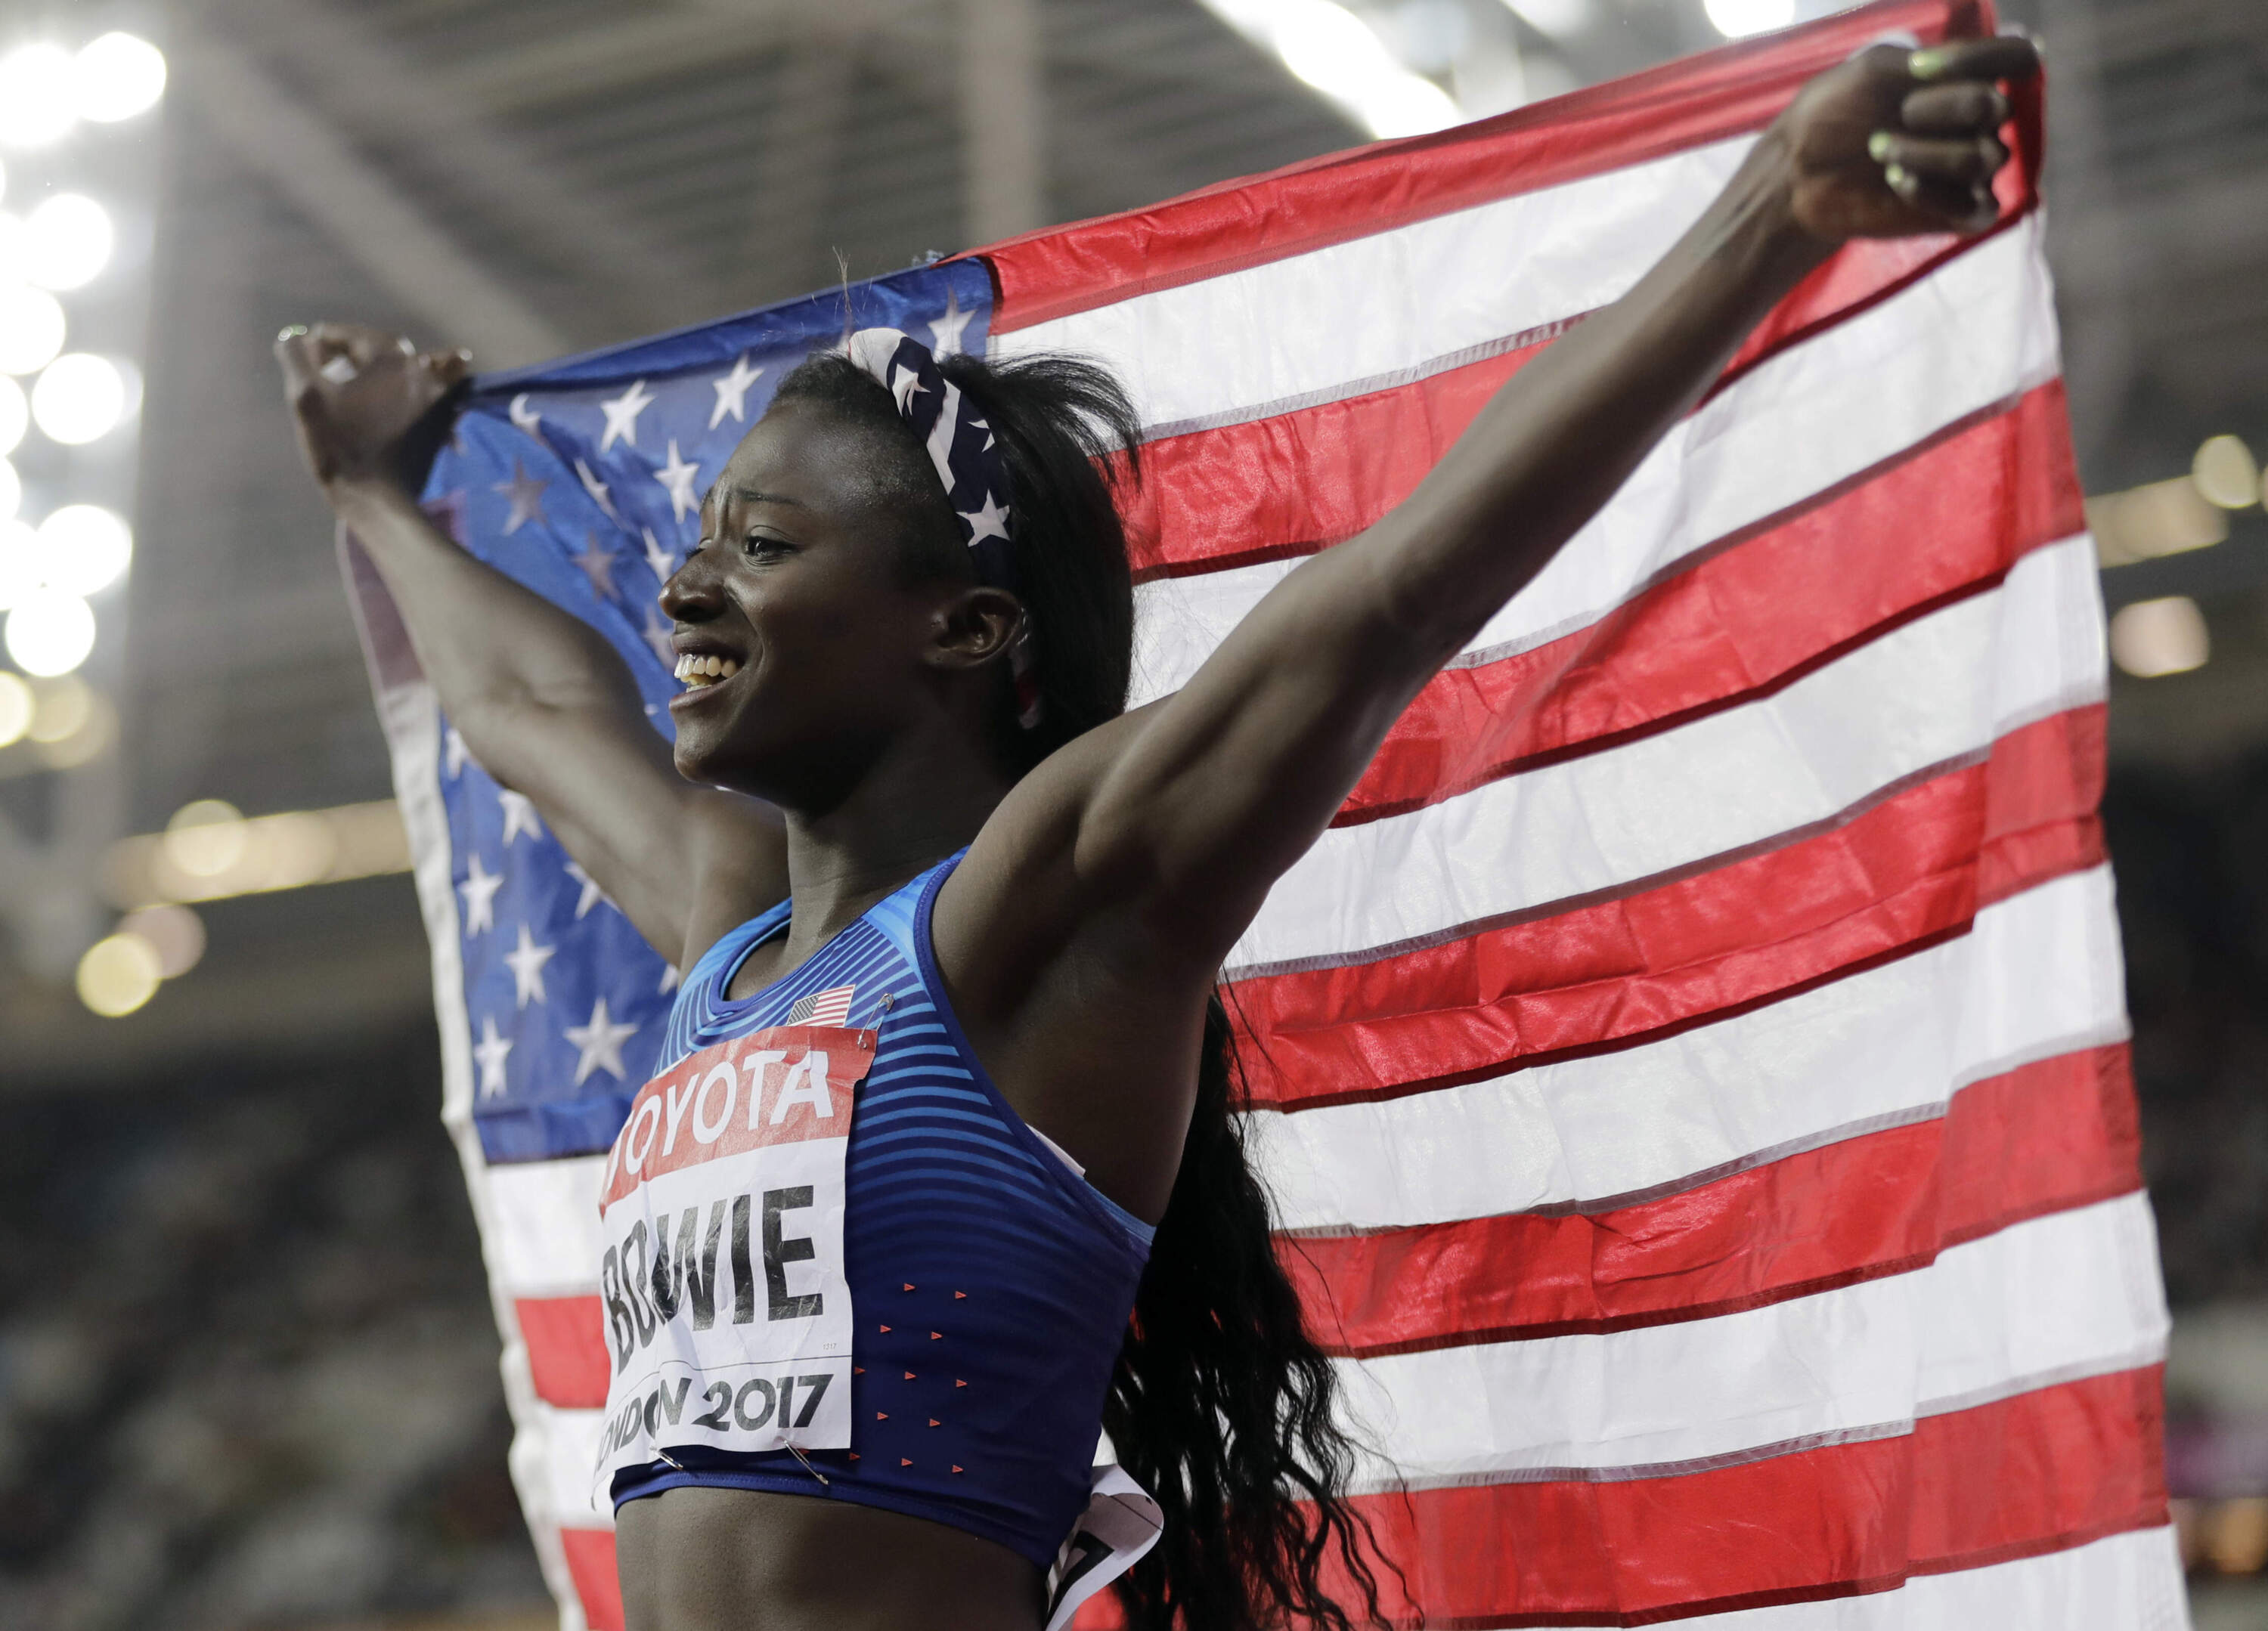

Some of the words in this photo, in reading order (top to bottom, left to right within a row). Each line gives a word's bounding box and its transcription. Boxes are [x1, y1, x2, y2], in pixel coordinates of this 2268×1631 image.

[606, 1050, 835, 1191] TOYOTA
[603, 1184, 824, 1377] BOWIE
[690, 1373, 835, 1432] 2017
